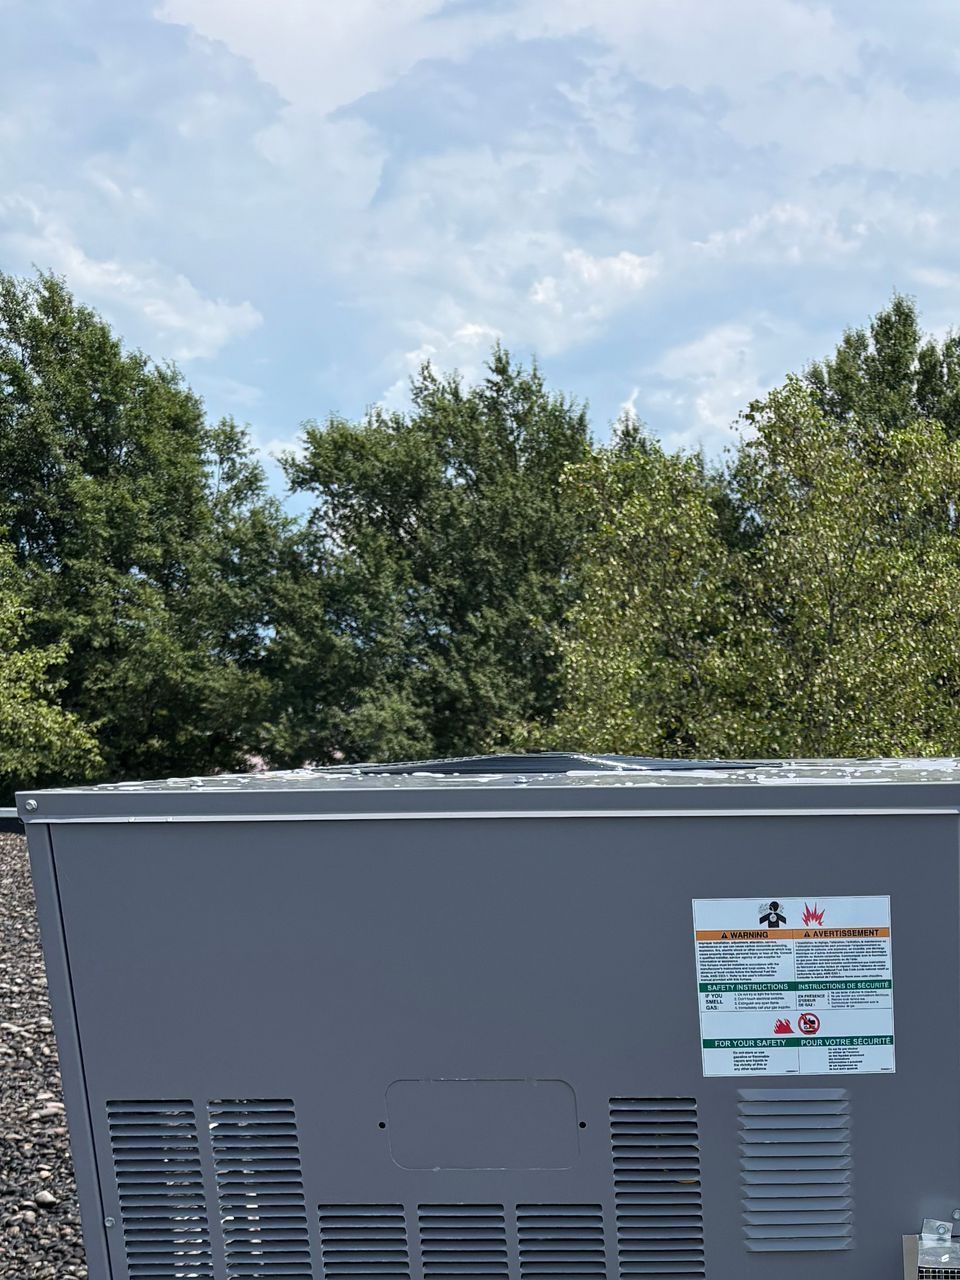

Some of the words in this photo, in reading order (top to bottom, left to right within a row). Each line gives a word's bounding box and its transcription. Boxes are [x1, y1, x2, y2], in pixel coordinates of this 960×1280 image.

[731, 931, 768, 939] WARNING
[813, 929, 879, 937] AVERTISSEMENT
[853, 1037, 891, 1045] SÉCURITÉ
